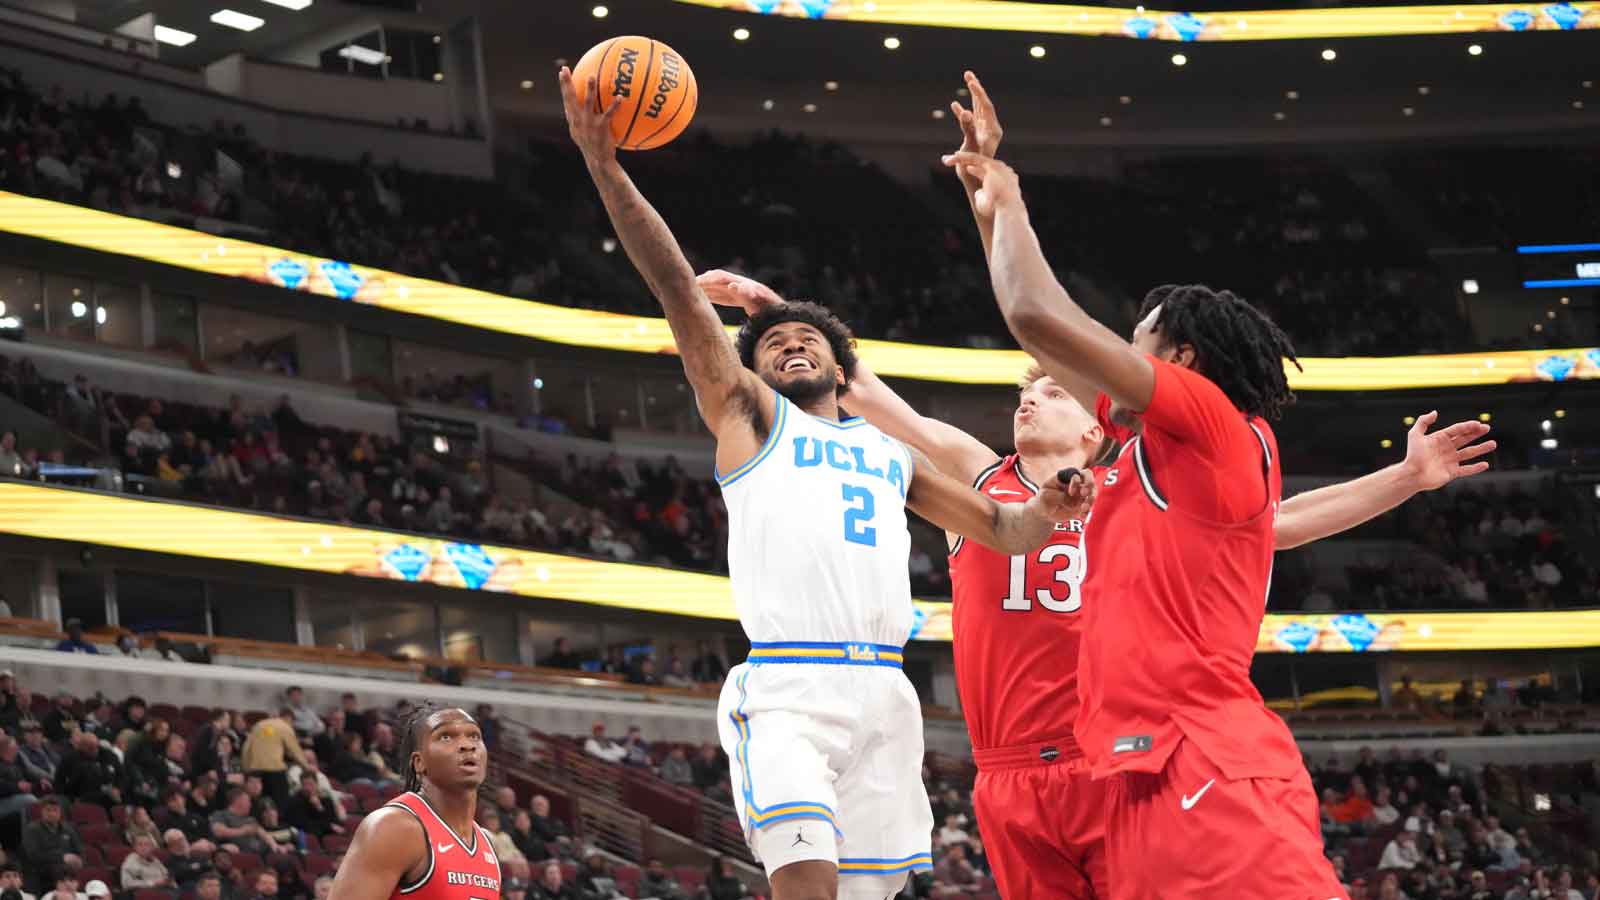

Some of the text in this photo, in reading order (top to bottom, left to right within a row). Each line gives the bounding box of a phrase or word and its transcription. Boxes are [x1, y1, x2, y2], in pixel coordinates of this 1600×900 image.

[612, 48, 639, 97] NCAA
[645, 51, 680, 119] Wilson
[793, 436, 905, 500] UCLA
[842, 483, 876, 547] 2
[1002, 543, 1083, 612] 13
[447, 871, 500, 893] RUTGERS
